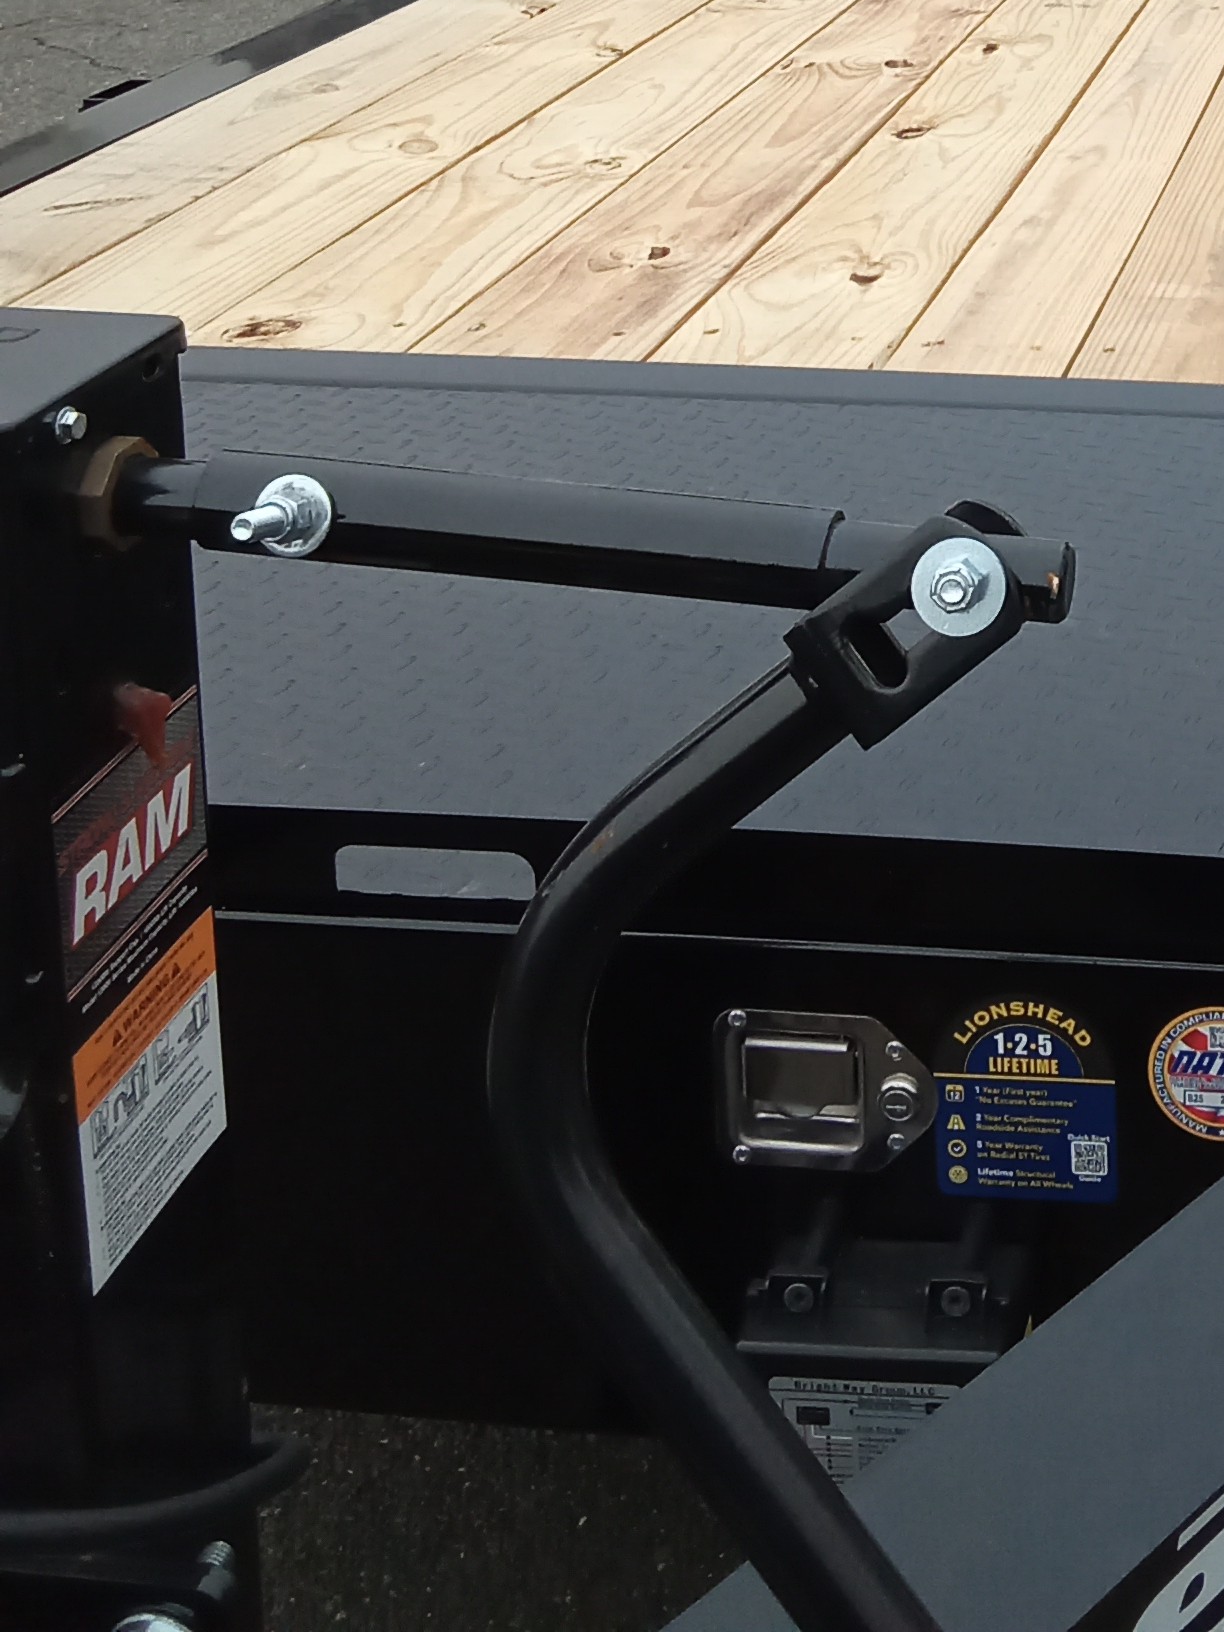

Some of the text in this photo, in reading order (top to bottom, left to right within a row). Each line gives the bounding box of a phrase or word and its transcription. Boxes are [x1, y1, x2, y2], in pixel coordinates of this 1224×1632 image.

[72, 762, 192, 946] RAM
[954, 1001, 1092, 1047] LIONSHEAD
[1162, 1039, 1172, 1050] IN
[988, 1057, 1059, 1075] LIFETIME
[983, 1086, 1001, 1095] Year
[1153, 1050, 1208, 1134] MANUFACTURED
[977, 1168, 1014, 1177] Lifetime
